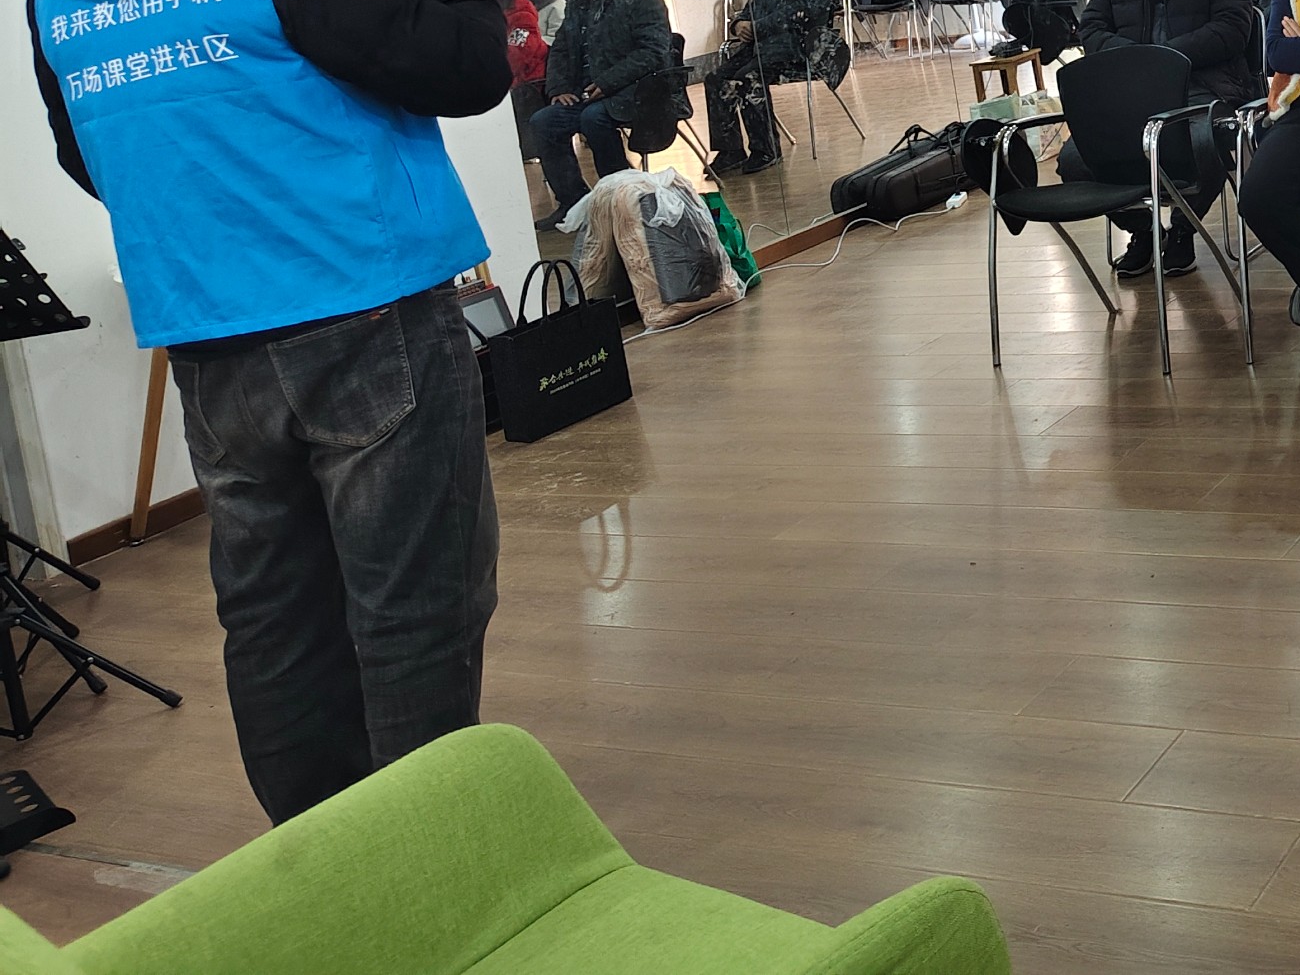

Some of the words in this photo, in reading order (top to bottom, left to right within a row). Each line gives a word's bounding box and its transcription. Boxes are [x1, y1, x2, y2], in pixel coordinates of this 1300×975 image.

[66, 33, 239, 101] 万场课堂进社区
